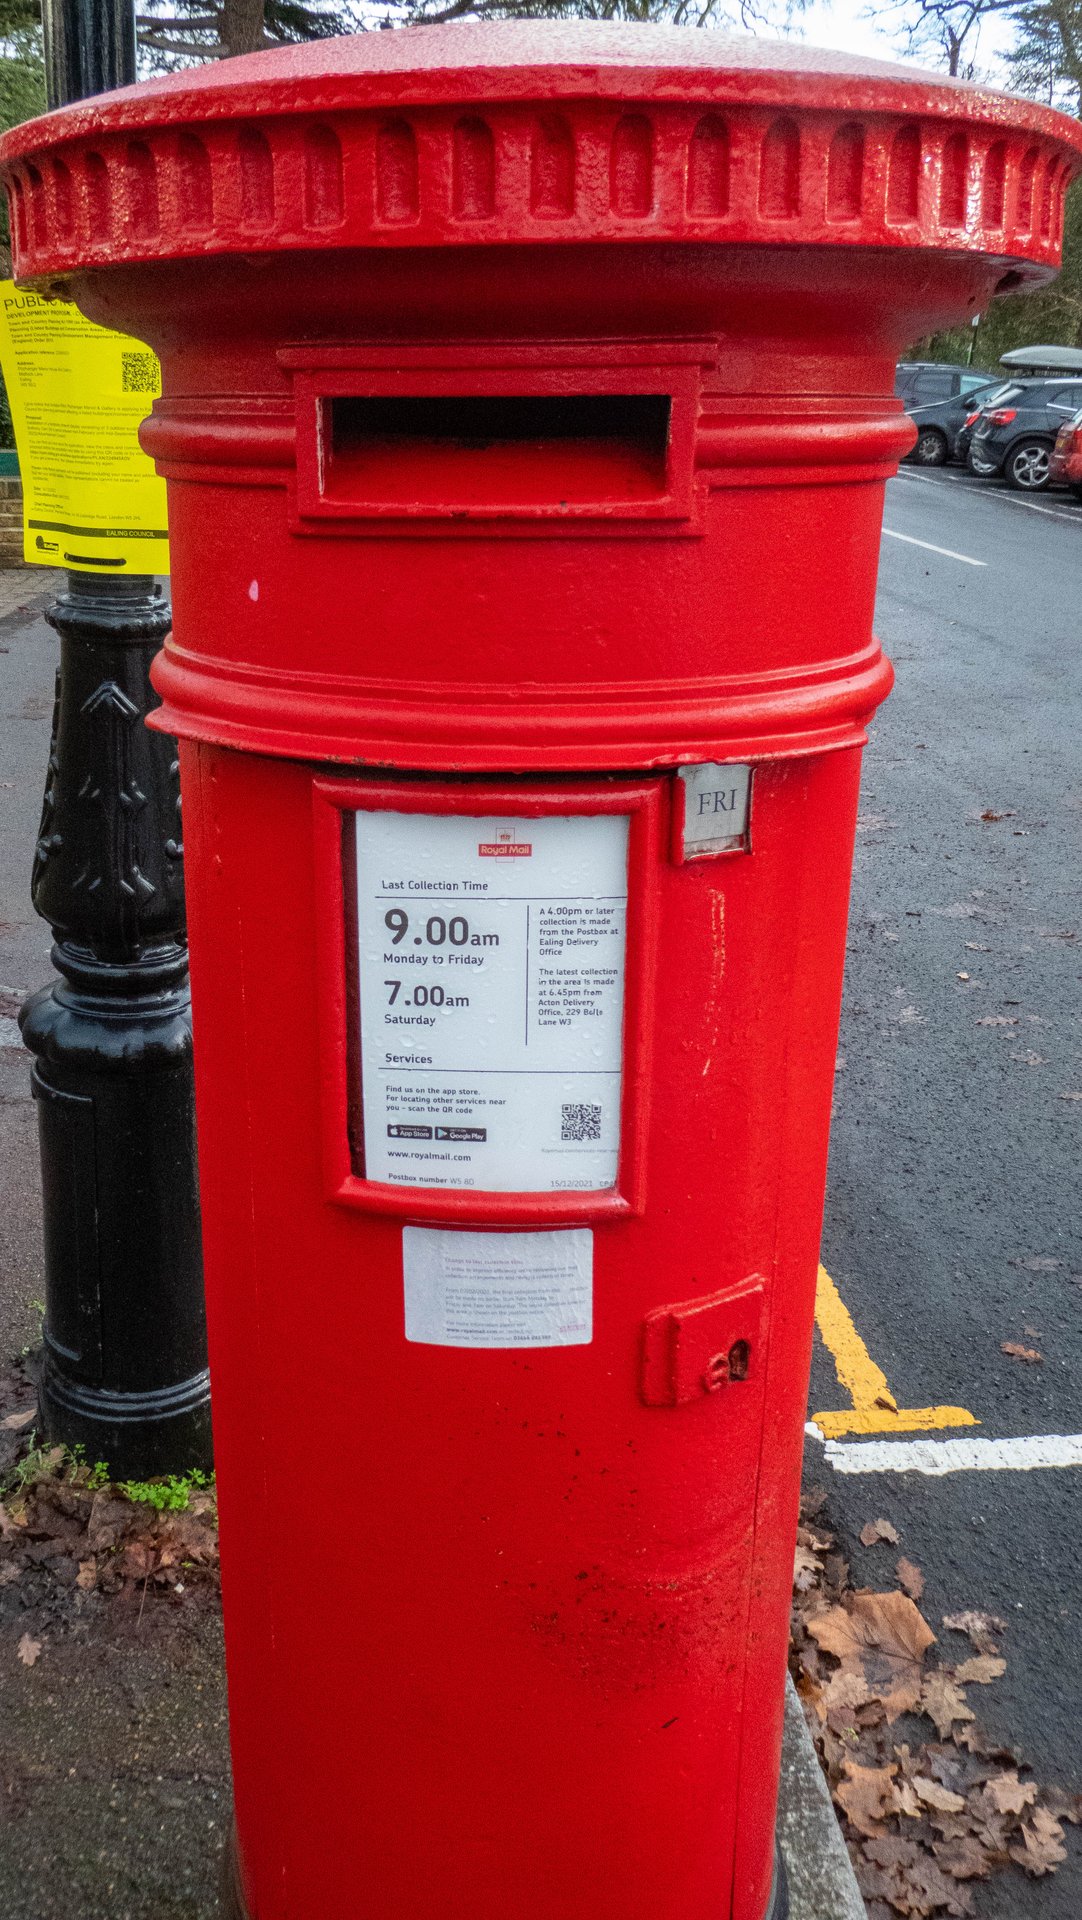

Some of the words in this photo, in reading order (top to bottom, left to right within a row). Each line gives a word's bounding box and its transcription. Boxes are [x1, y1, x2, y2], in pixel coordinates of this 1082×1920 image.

[6, 310, 50, 319] DEVELOPMENT
[697, 788, 738, 815] FRI
[481, 845, 507, 856] Royal
[509, 845, 529, 855] Mail
[382, 880, 404, 890] Last
[408, 881, 459, 891] Collection
[463, 881, 489, 891] Time
[547, 907, 582, 916] 4.00pm
[539, 939, 564, 947] Ealing
[383, 953, 428, 965] Monday
[432, 954, 444, 965] to
[448, 954, 484, 966] Friday
[539, 978, 546, 986] in
[549, 989, 581, 998] 6.45pm
[563, 999, 595, 1007] Delivery
[384, 1014, 436, 1027] Saturday
[385, 1052, 433, 1065] Services
[386, 1085, 402, 1093] Find
[427, 1087, 440, 1095] the
[442, 1088, 456, 1097] app
[459, 1088, 481, 1096] store.
[400, 1095, 431, 1105] locating
[427, 1105, 440, 1113] the
[442, 1106, 453, 1114] QR
[455, 1106, 473, 1114] code
[387, 1149, 472, 1162] www.royalmail.com
[388, 1172, 417, 1183] Postbox
[419, 1176, 448, 1184] number
[551, 1180, 592, 1188] 15/12/2021
